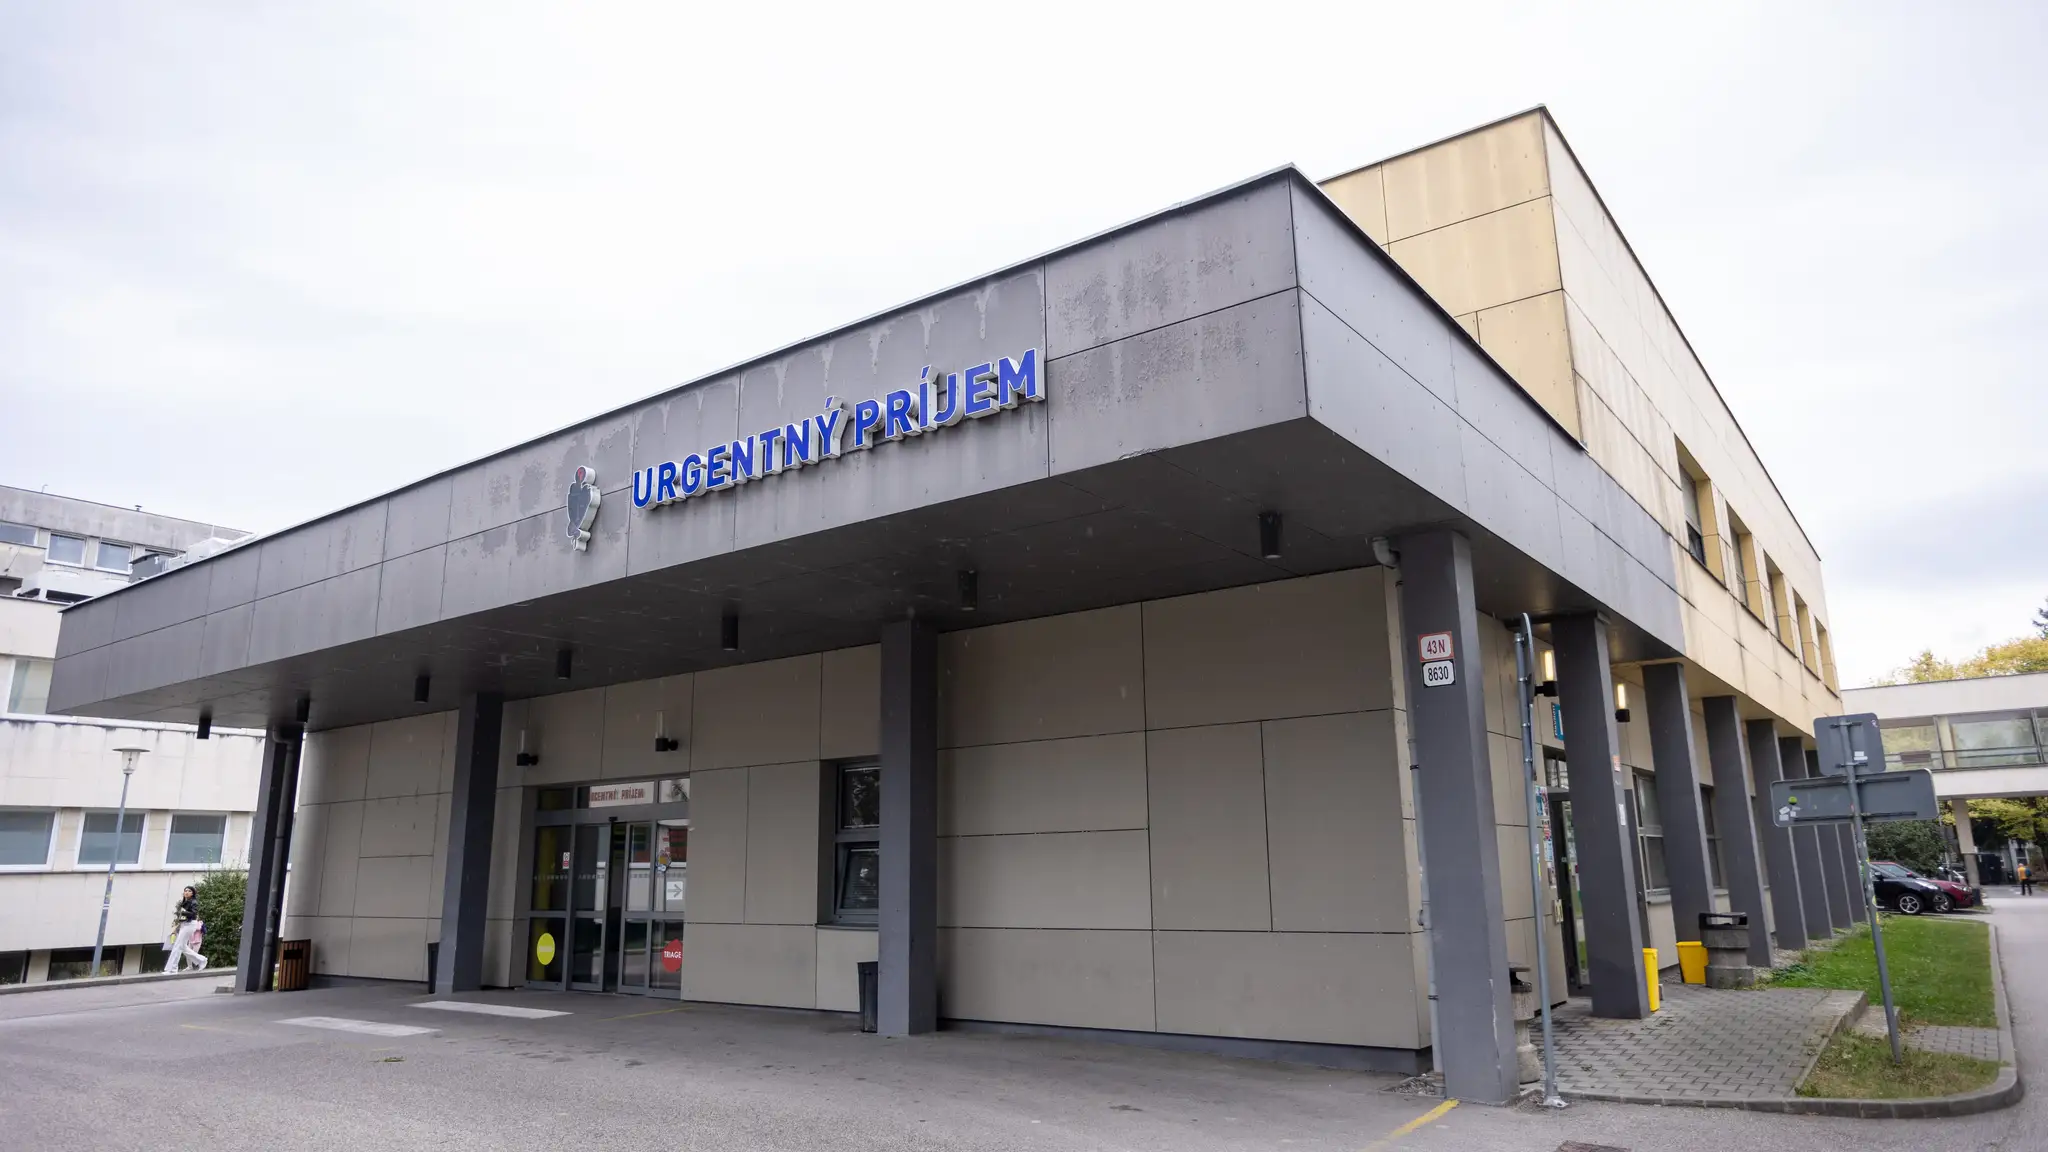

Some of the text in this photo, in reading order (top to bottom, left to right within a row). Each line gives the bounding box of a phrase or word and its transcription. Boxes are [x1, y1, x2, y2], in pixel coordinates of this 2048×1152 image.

[632, 347, 1042, 510] URGENTNÝ PRÍJEM
[1428, 666, 1449, 681] 8630
[664, 951, 682, 959] TRIAGE
